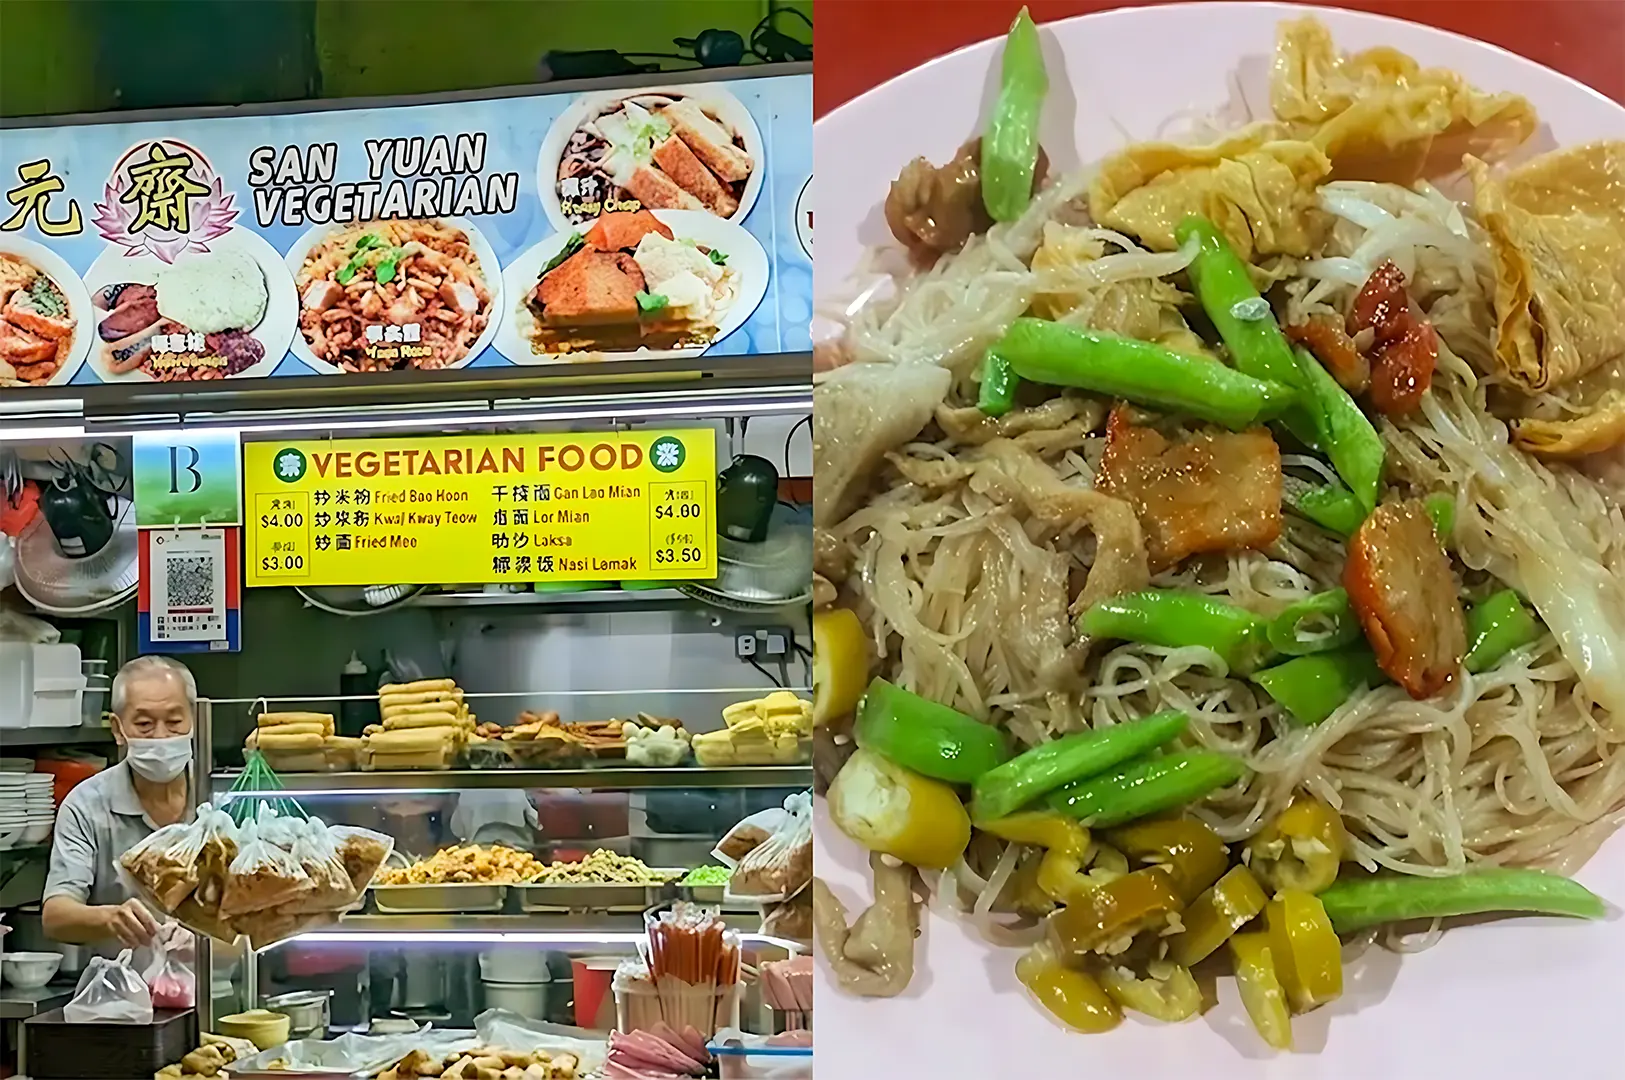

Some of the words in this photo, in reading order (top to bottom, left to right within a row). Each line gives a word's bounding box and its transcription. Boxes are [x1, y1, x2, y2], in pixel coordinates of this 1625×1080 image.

[248, 142, 338, 188] SAN
[364, 132, 488, 183] YUAN
[253, 172, 519, 228] VEGETARIAN
[312, 447, 525, 478] VEGETARIAN
[538, 443, 643, 472] FOOD
[167, 445, 203, 494] B
[374, 489, 406, 504] Fried
[436, 488, 469, 502] Hoon
[608, 485, 641, 499] Mian
[533, 510, 554, 524] Lor
[557, 510, 590, 523] Mian
[655, 503, 701, 520] $4.00
[261, 513, 303, 528] $4.00
[355, 535, 387, 549] Fried
[261, 556, 304, 571] $3.00
[655, 547, 702, 564] $3.50
[558, 557, 588, 571] Nasi
